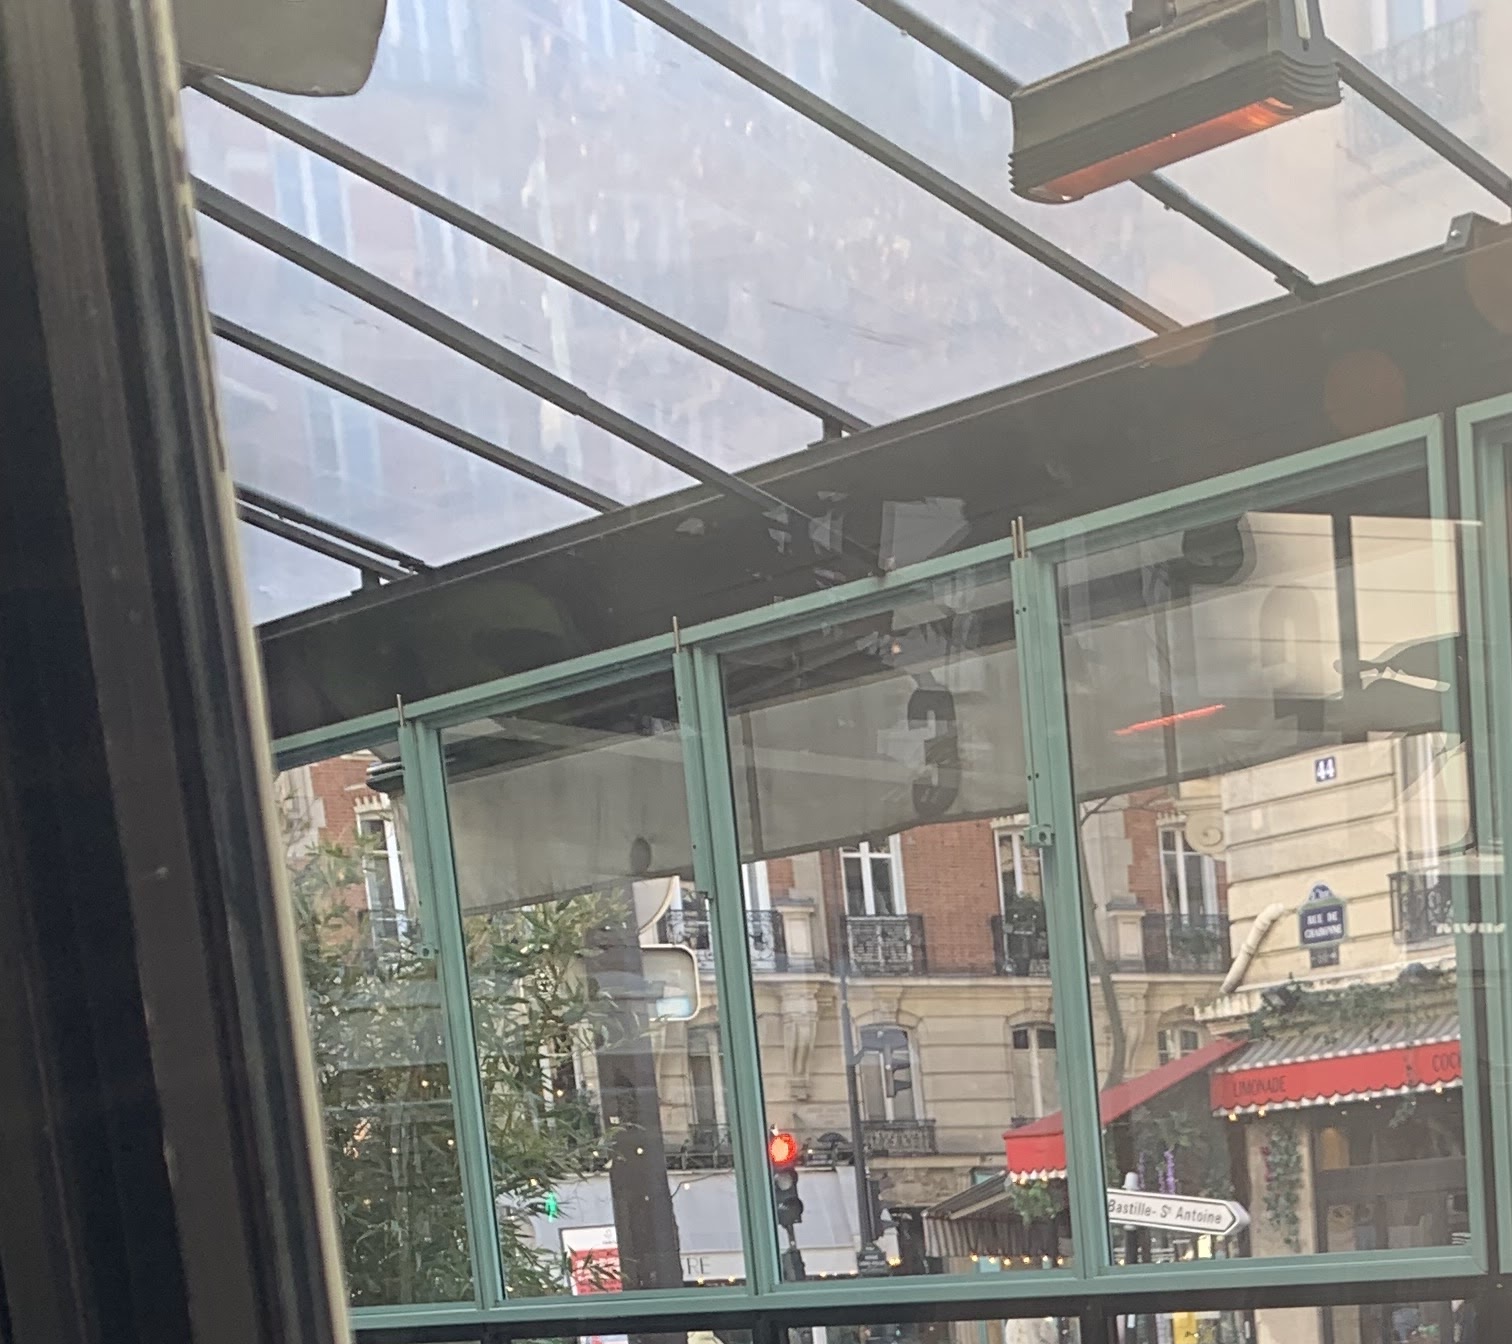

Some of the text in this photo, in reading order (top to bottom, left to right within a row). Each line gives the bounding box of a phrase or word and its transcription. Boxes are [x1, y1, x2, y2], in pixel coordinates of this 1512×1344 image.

[1317, 758, 1334, 779] 44
[1432, 1052, 1461, 1072] COC
[1175, 1206, 1223, 1225] Antoine
[683, 1255, 712, 1276] RE
